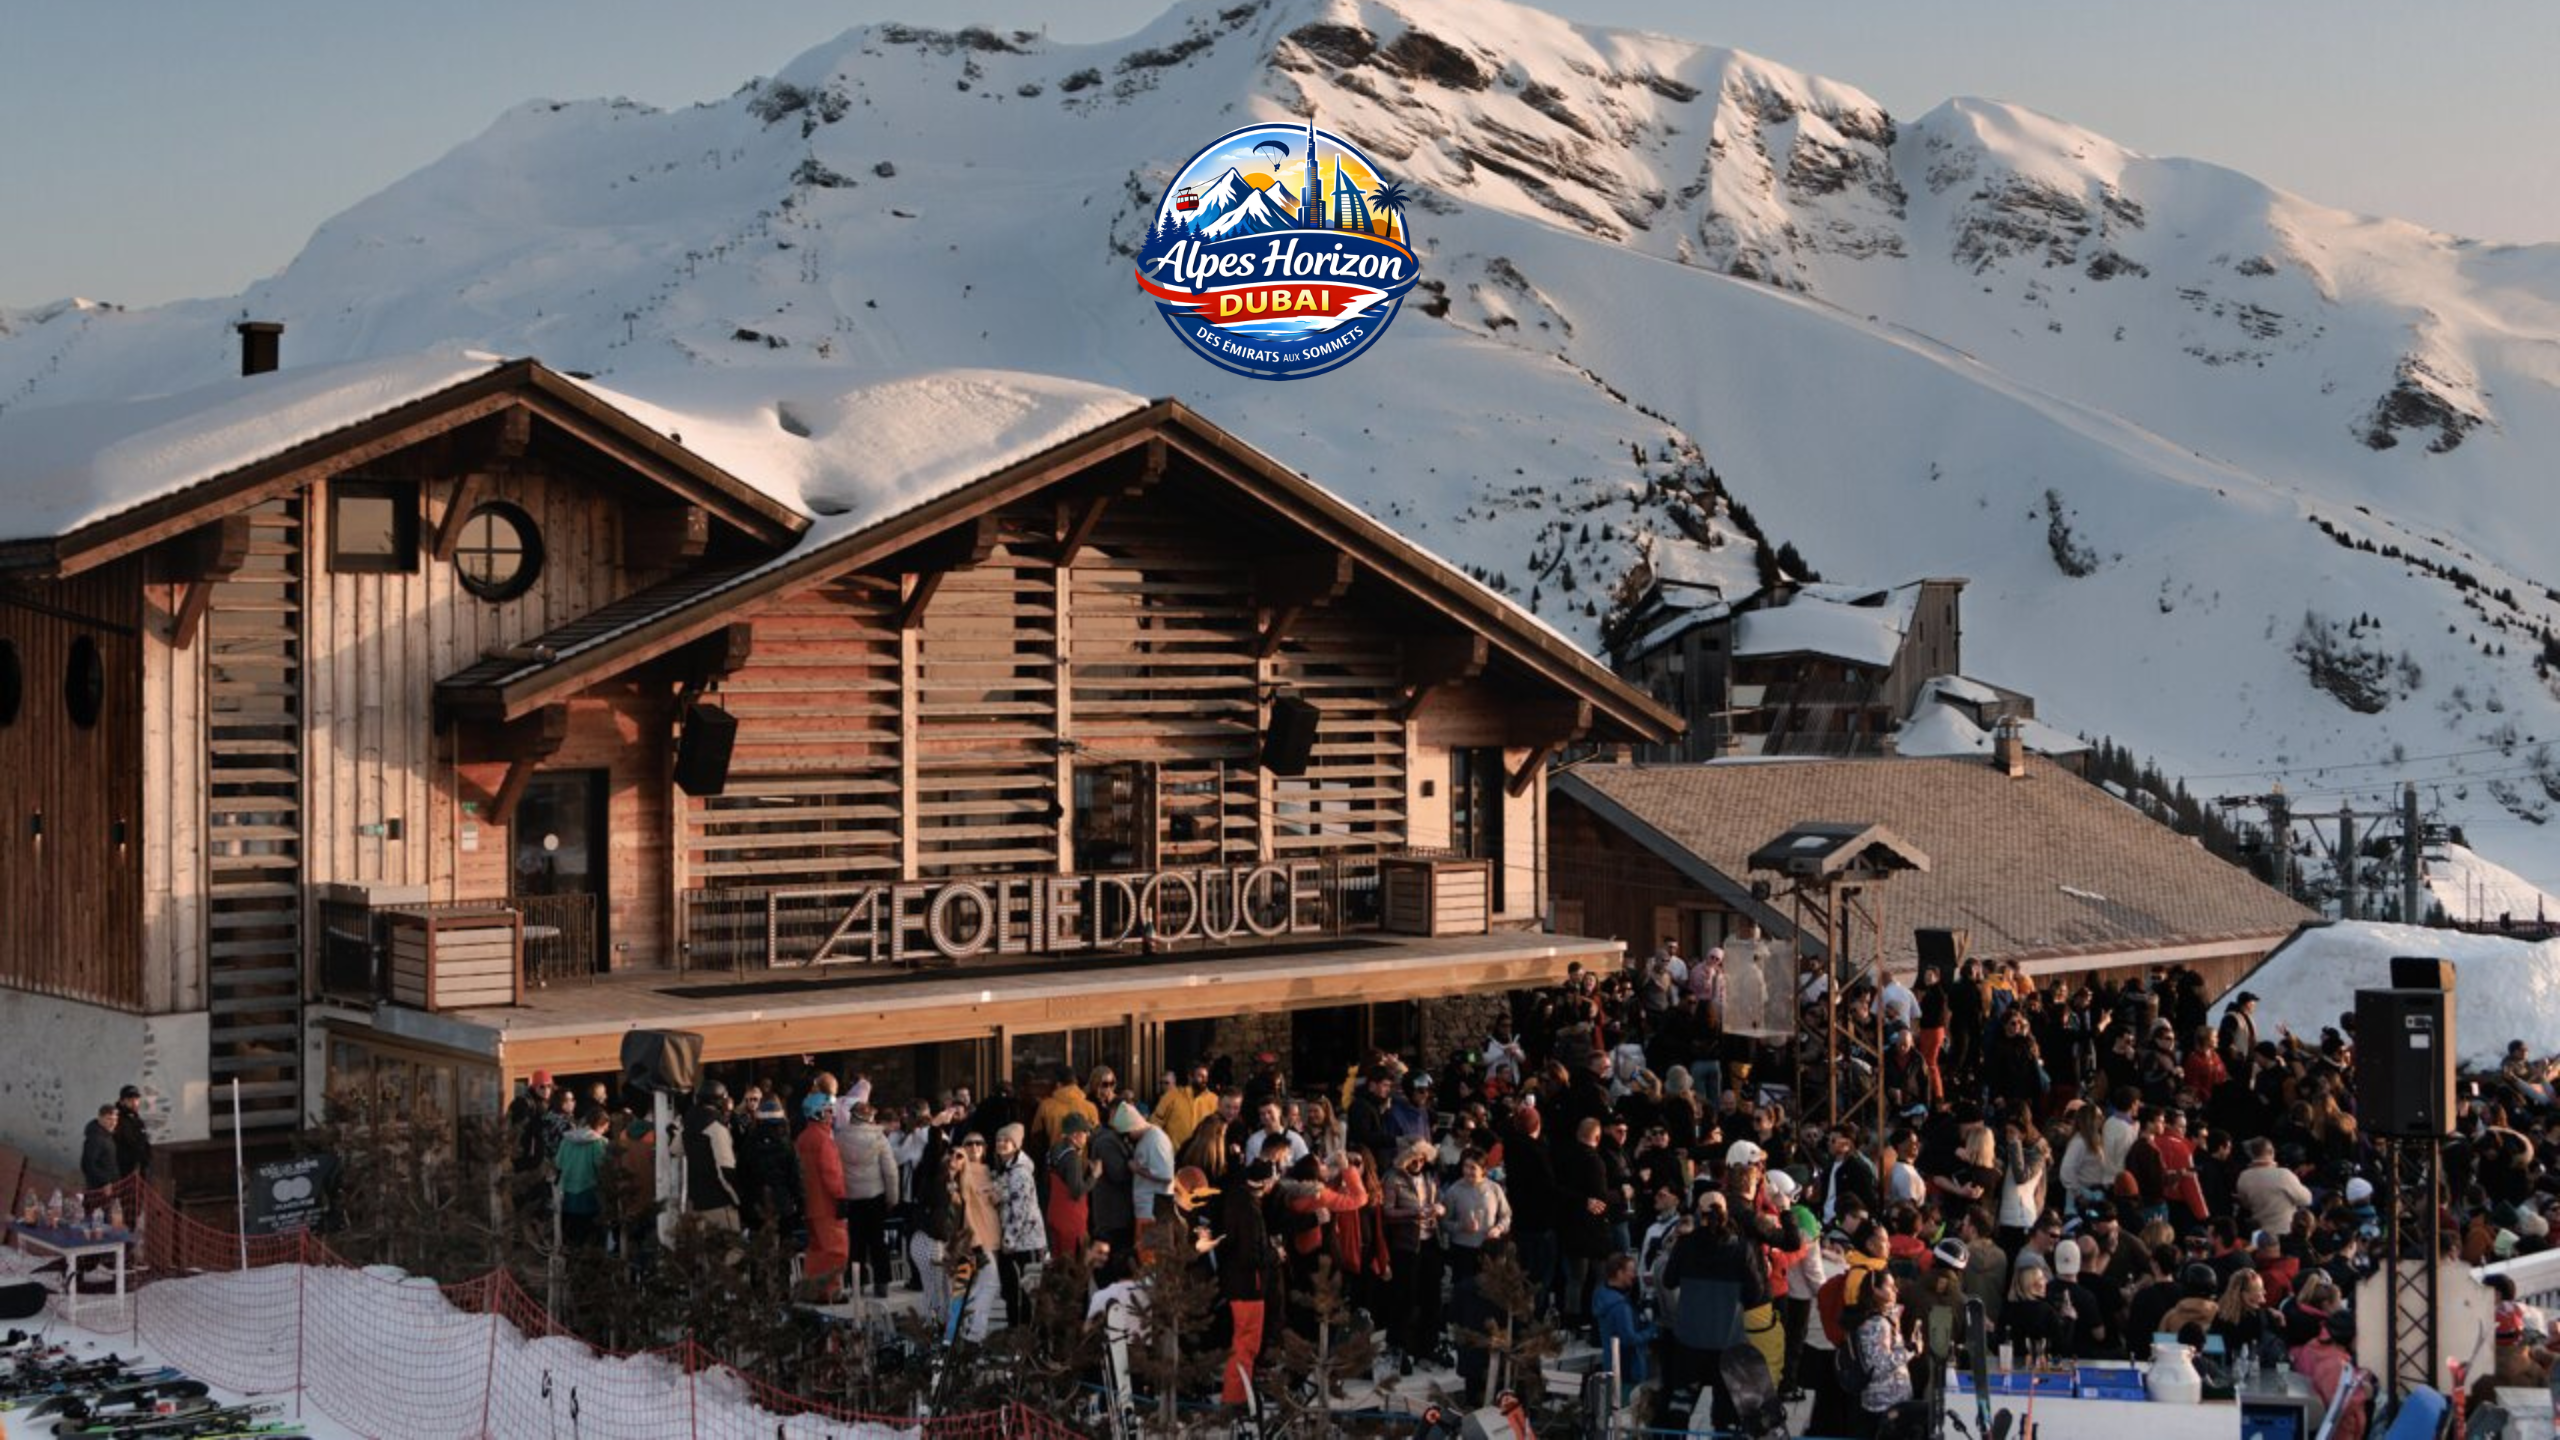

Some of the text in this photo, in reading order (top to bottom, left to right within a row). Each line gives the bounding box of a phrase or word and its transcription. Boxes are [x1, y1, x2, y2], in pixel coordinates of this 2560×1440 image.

[767, 864, 1322, 968] LA FOLIE DOUCE
